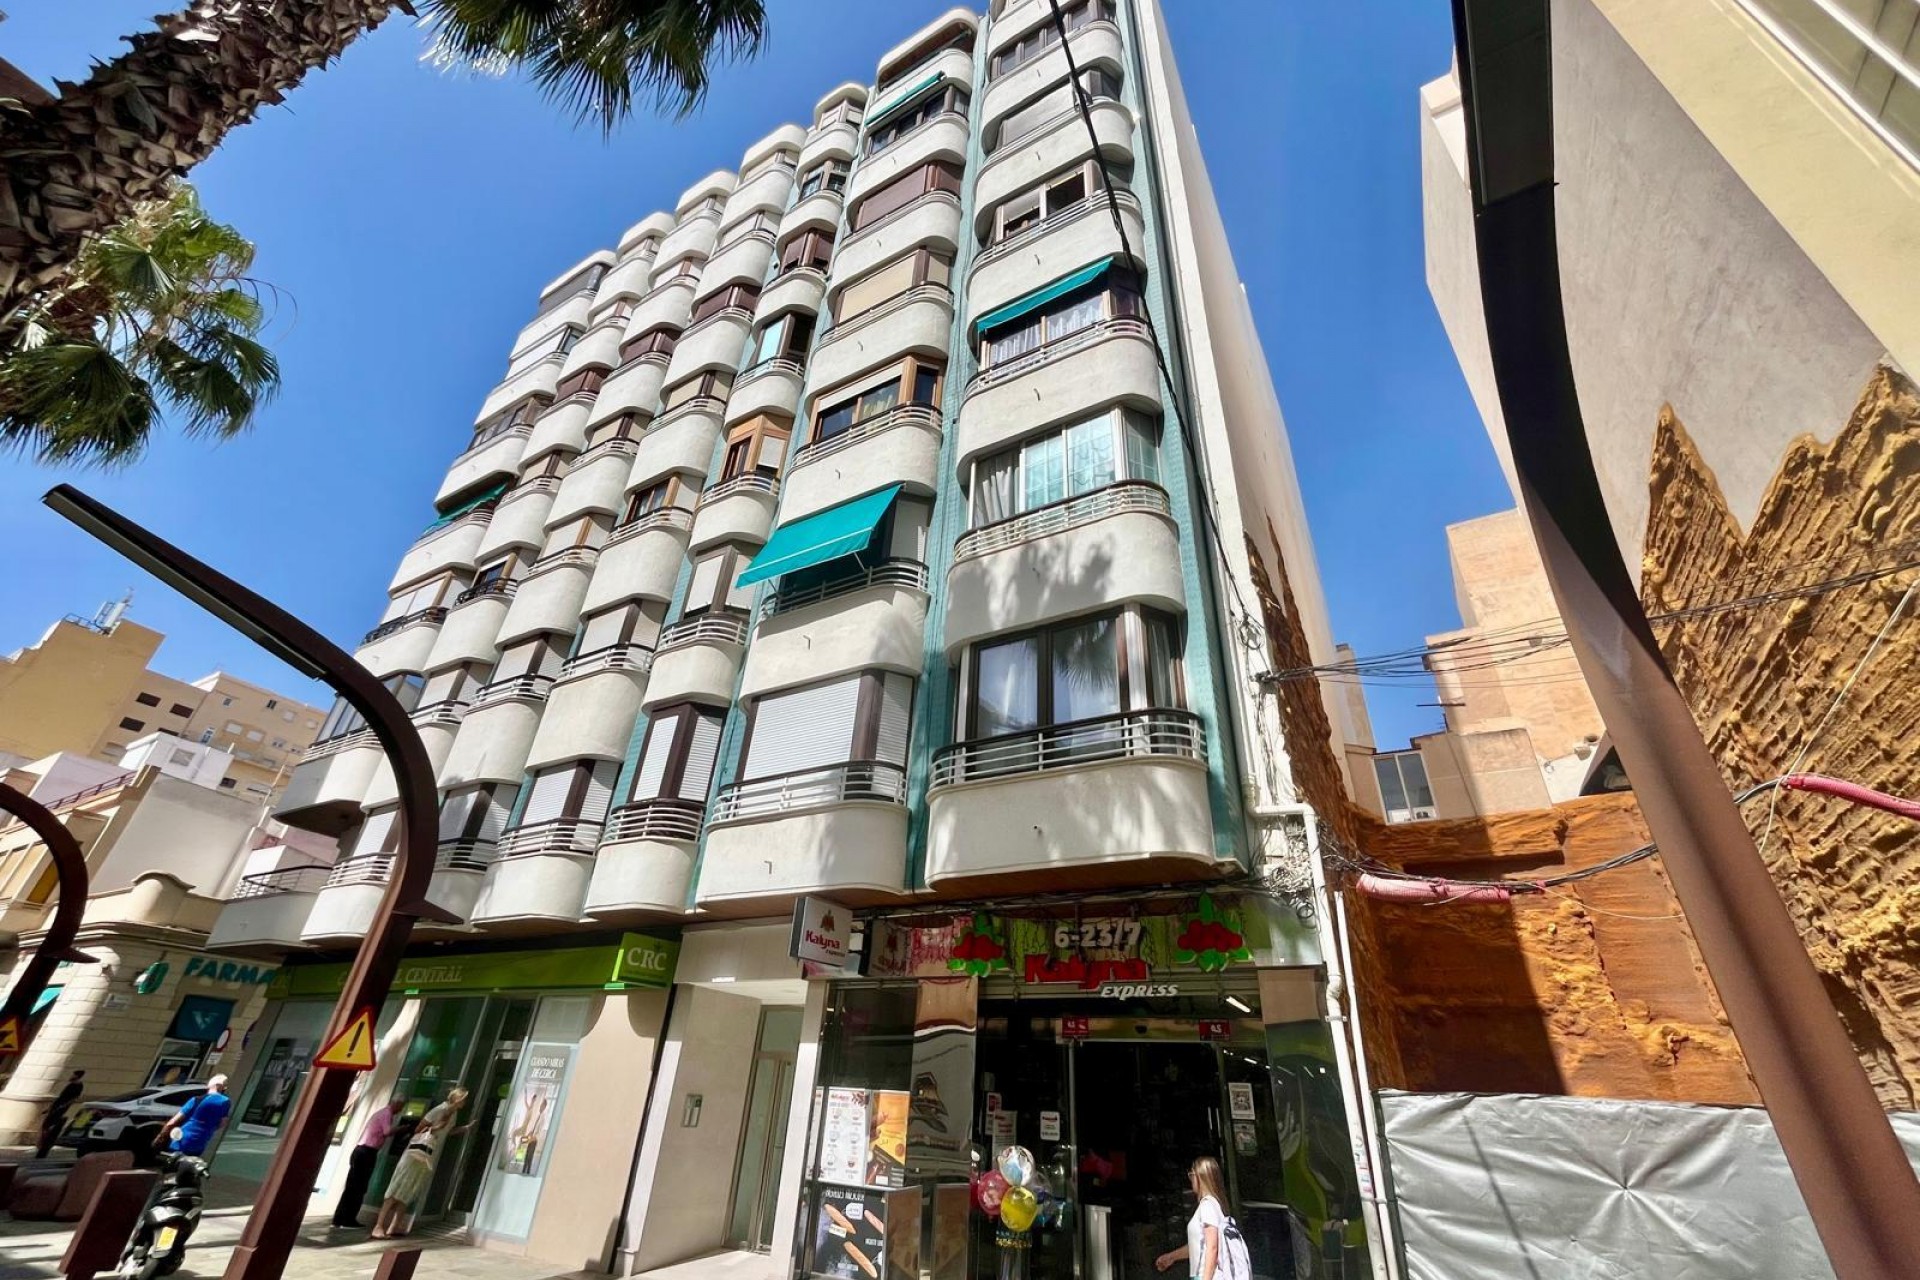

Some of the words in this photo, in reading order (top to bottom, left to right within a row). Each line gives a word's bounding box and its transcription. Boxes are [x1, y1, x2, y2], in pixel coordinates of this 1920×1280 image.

[805, 929, 840, 949] Kalyna
[627, 947, 667, 971] CRC
[405, 965, 462, 983] CENTRAL
[1100, 984, 1179, 1000] EXPRESS
